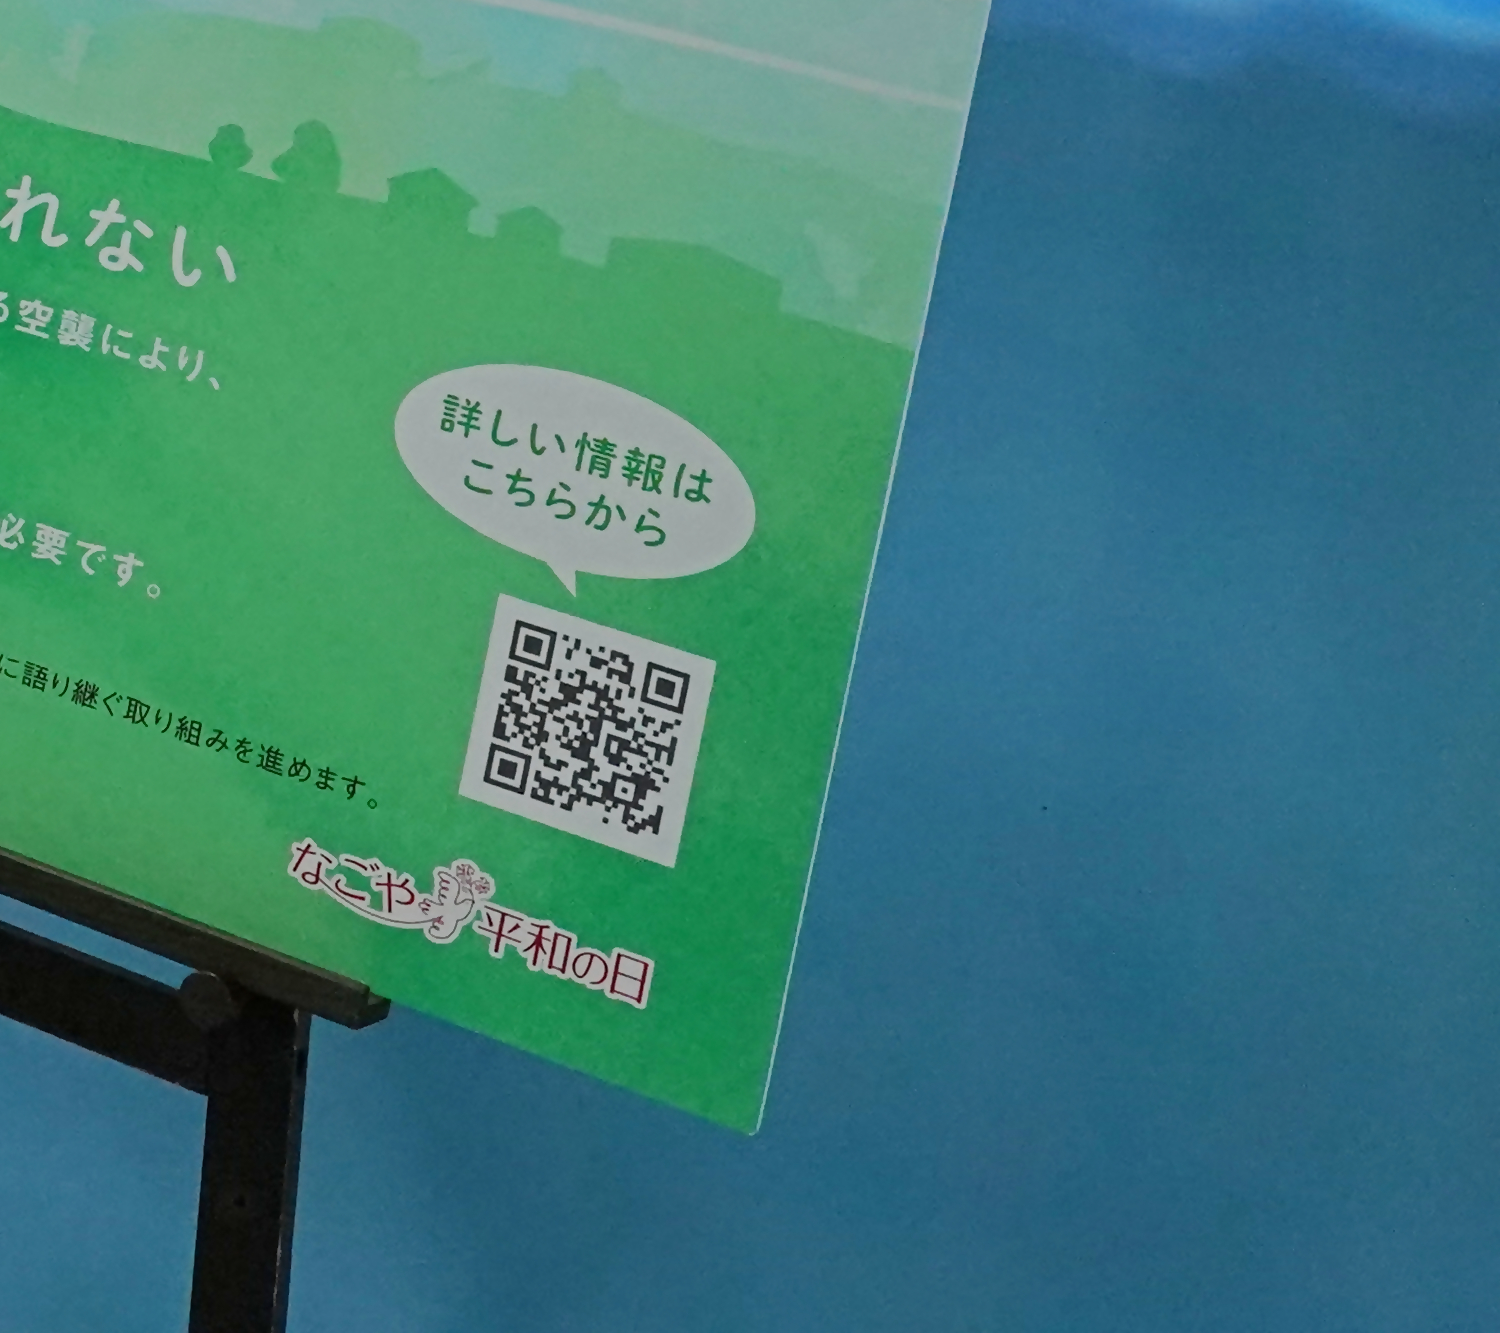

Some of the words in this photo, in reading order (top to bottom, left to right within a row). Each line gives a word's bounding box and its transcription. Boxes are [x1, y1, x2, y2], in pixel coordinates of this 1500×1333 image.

[440, 393, 713, 506] 詳しい情報は
[462, 458, 668, 548] こちらから
[291, 842, 415, 915] なごや
[477, 905, 650, 1006] 平和の日
